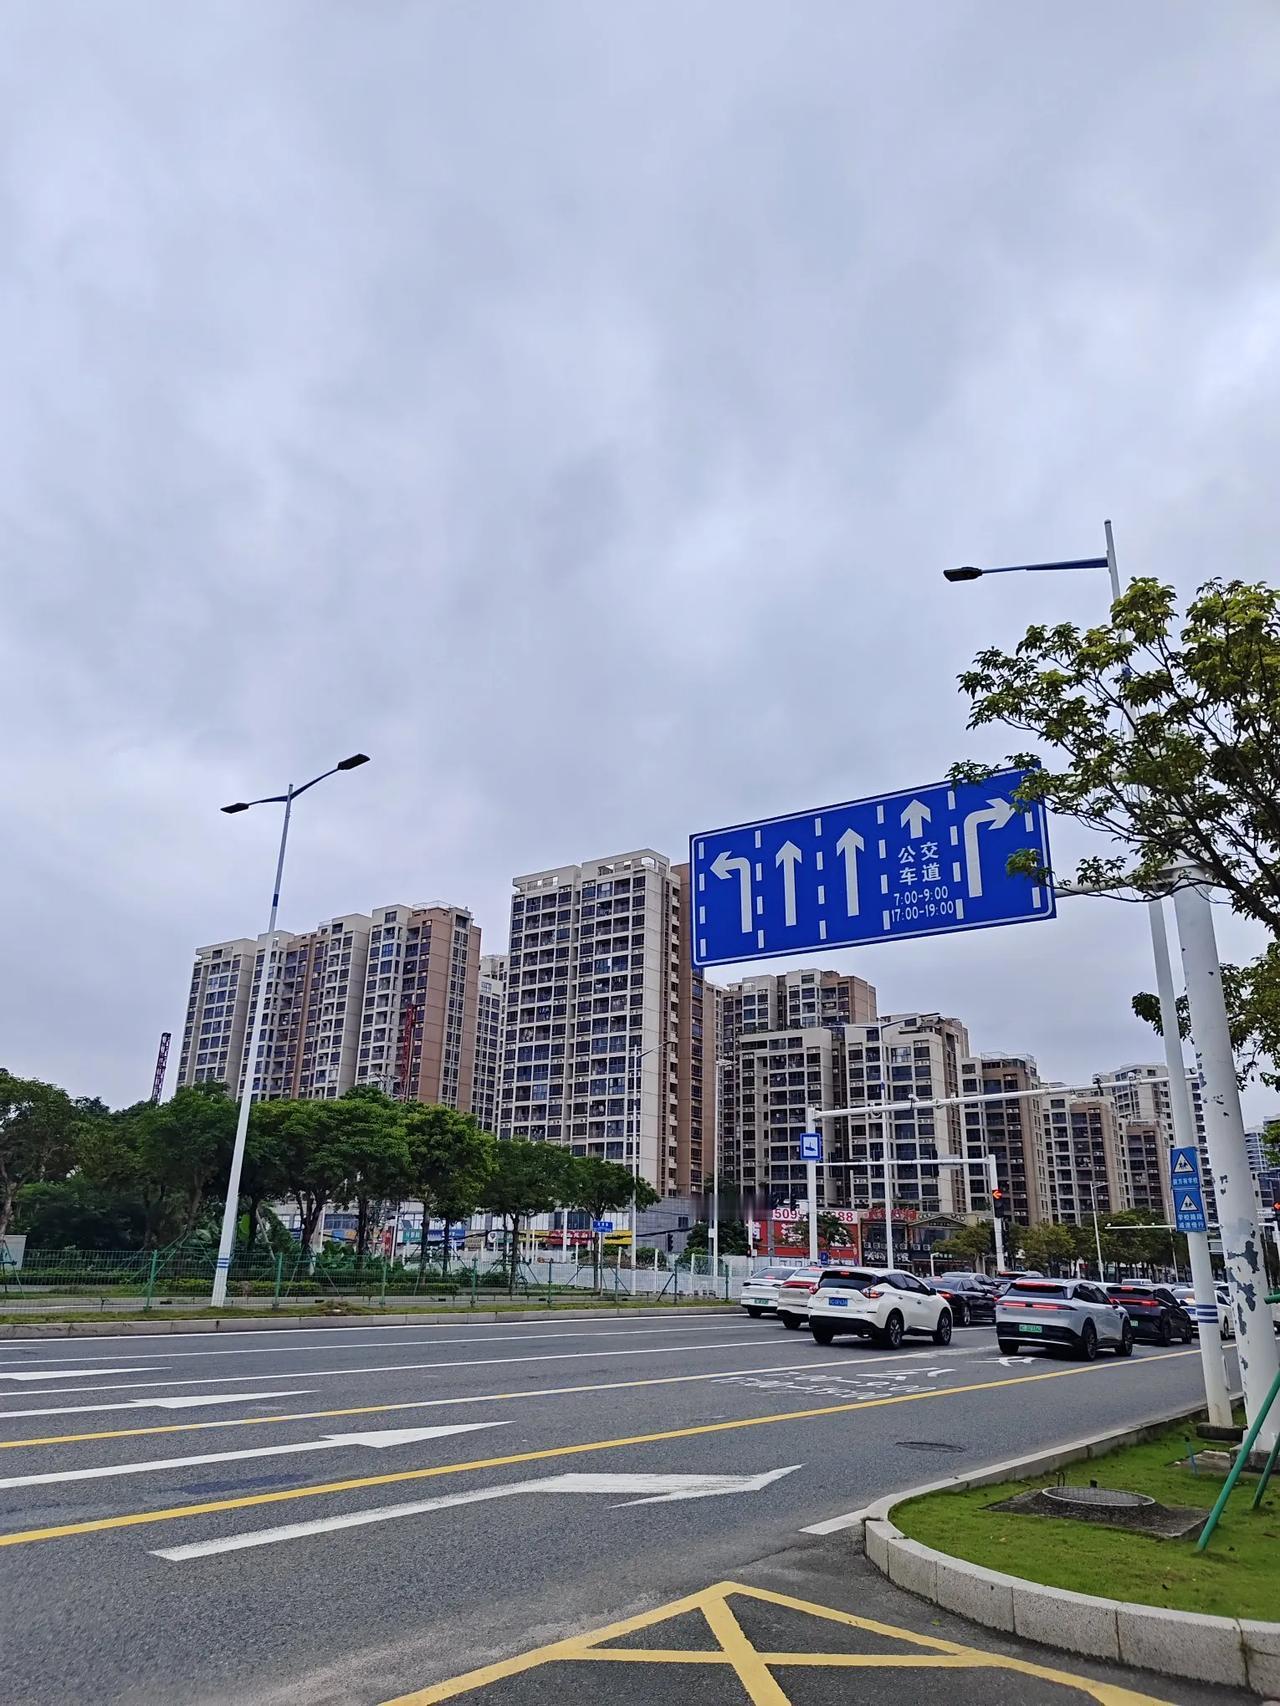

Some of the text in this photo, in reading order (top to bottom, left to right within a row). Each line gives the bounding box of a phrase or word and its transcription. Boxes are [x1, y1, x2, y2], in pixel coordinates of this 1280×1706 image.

[898, 841, 939, 864] 公交
[899, 862, 941, 886] 车道
[894, 885, 948, 906] 7:00-9:00
[891, 900, 954, 922] 17:00-19:00
